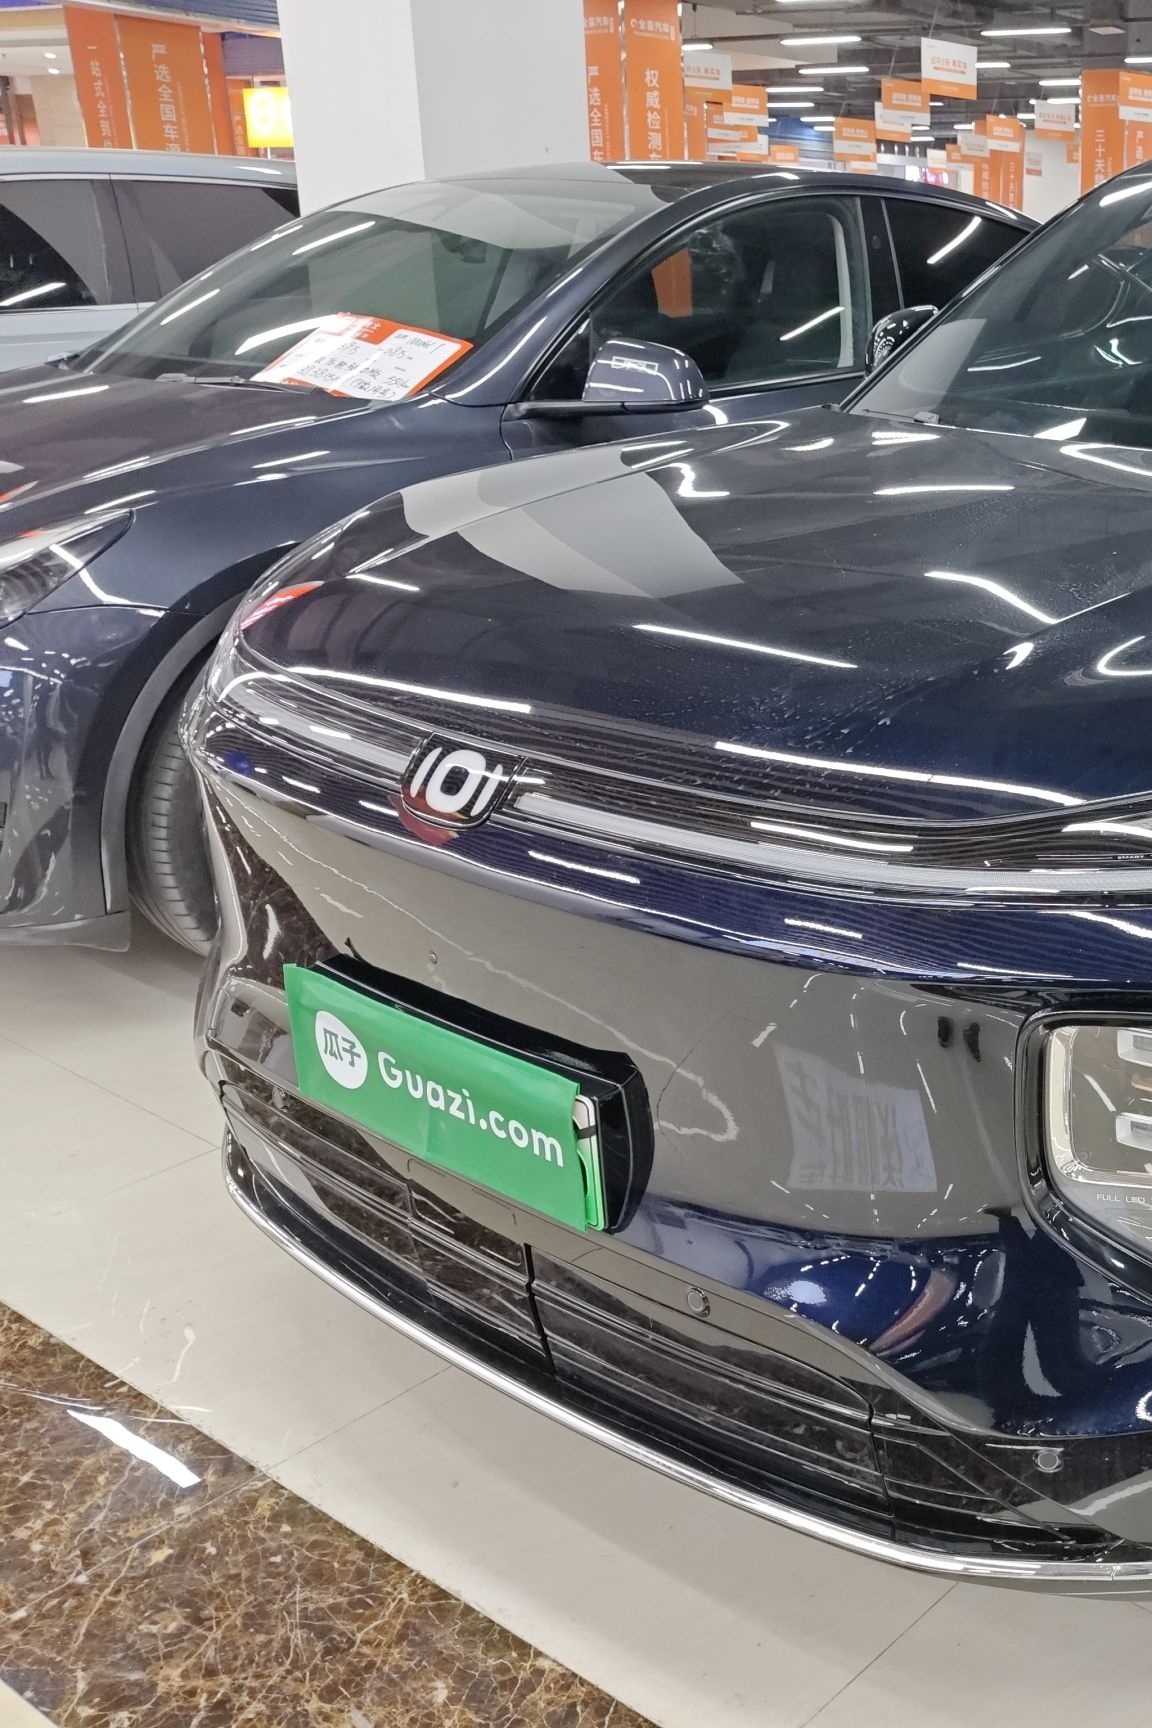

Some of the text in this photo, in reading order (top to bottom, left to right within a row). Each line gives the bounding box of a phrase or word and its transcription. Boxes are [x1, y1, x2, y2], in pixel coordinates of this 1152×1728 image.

[322, 1027, 362, 1067] 瓜子
[377, 1051, 564, 1167] Guazi.com
[1096, 1193, 1120, 1202] FULL
[1125, 1196, 1146, 1204] LED
